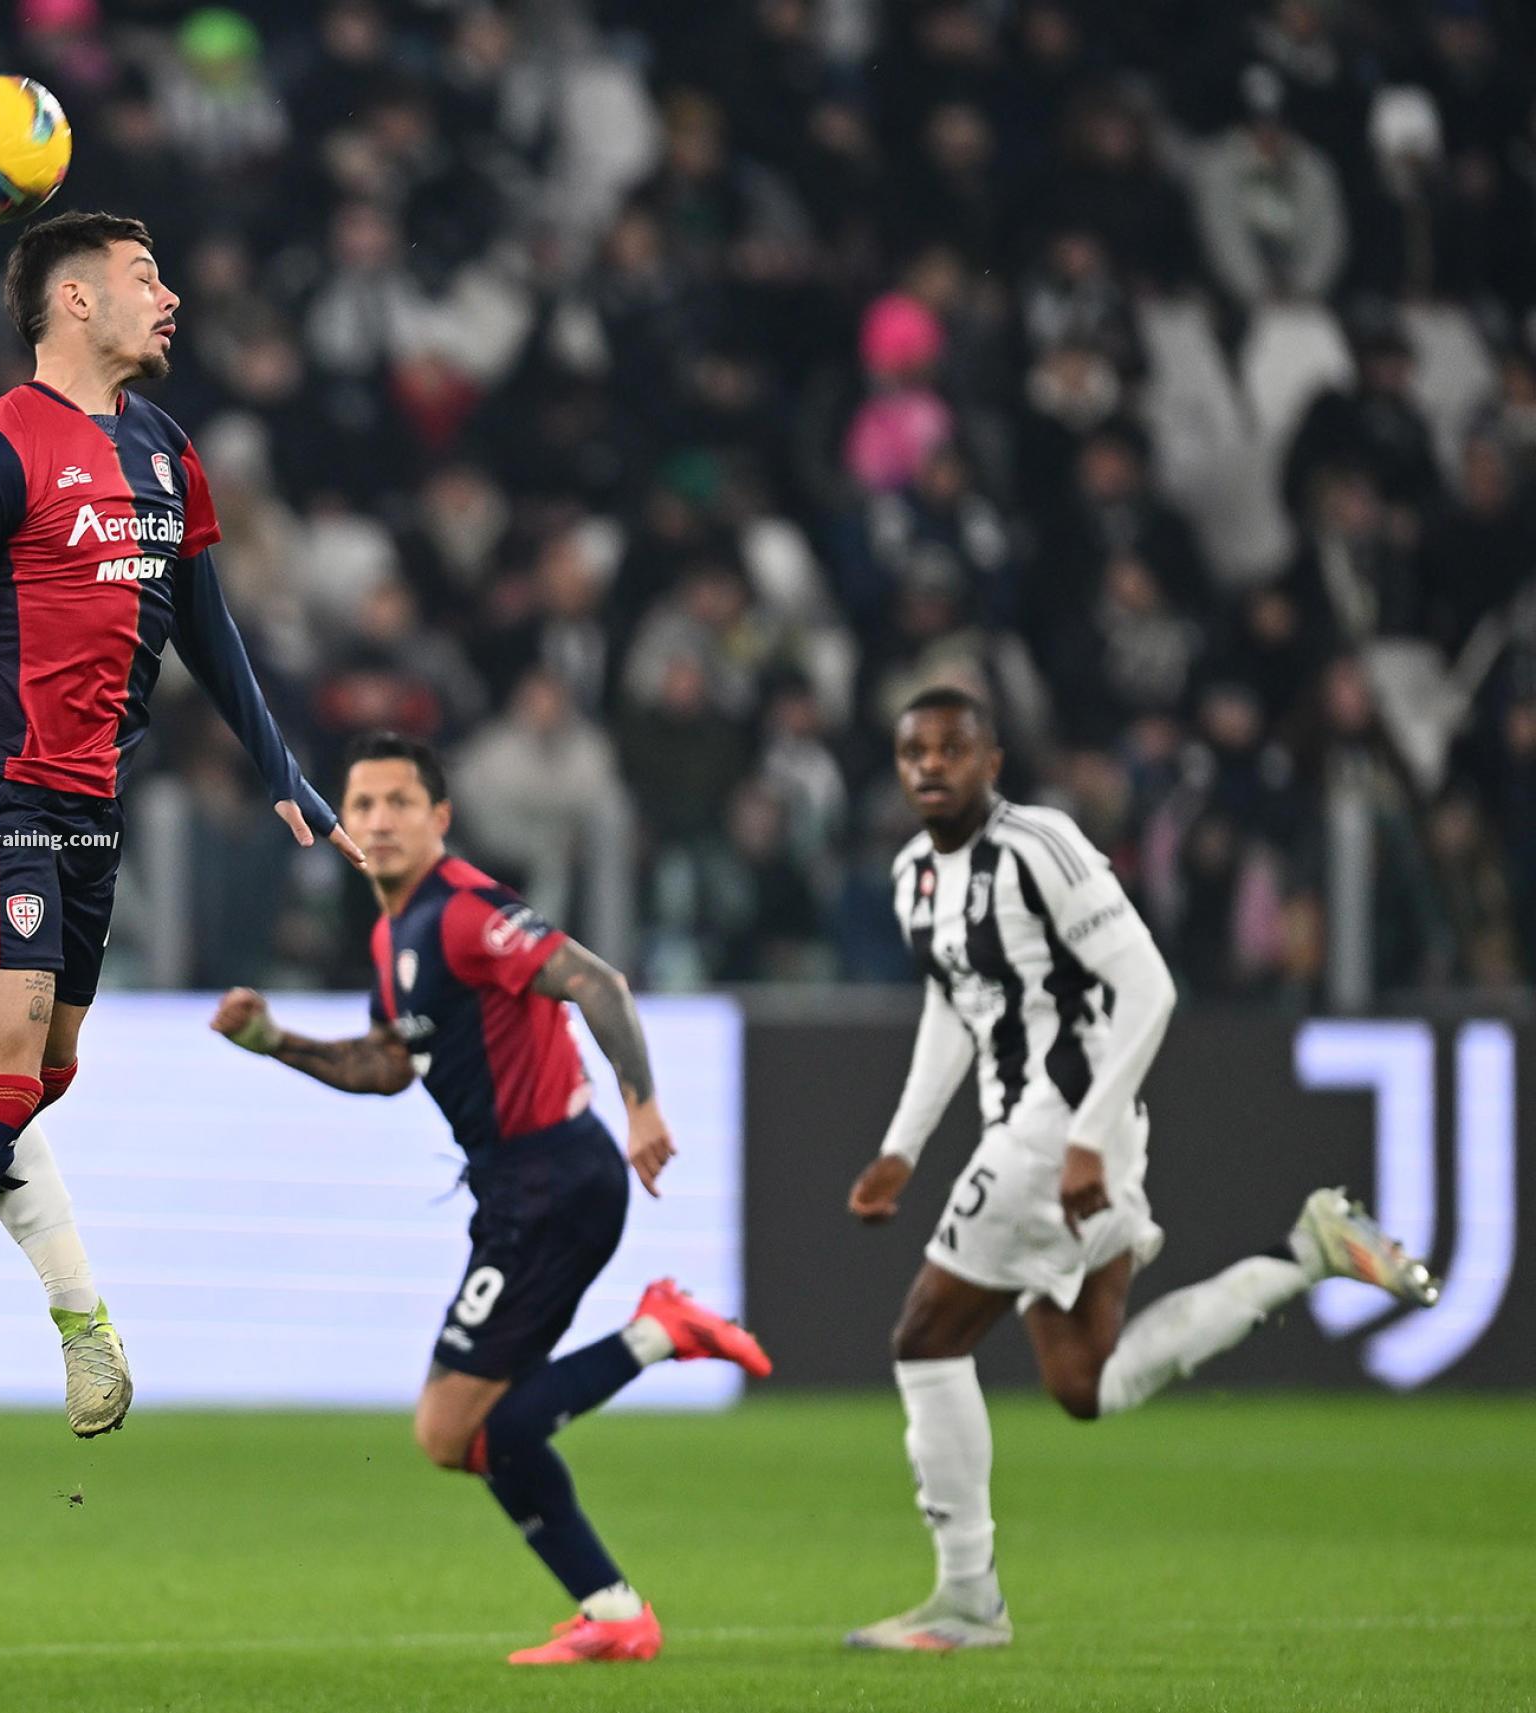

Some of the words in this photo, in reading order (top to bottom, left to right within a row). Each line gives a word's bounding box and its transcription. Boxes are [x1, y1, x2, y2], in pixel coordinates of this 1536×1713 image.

[67, 503, 184, 547] Aeroitalia
[96, 557, 167, 581] MOBY
[954, 1168, 996, 1218] 5
[455, 1266, 505, 1326] 9
